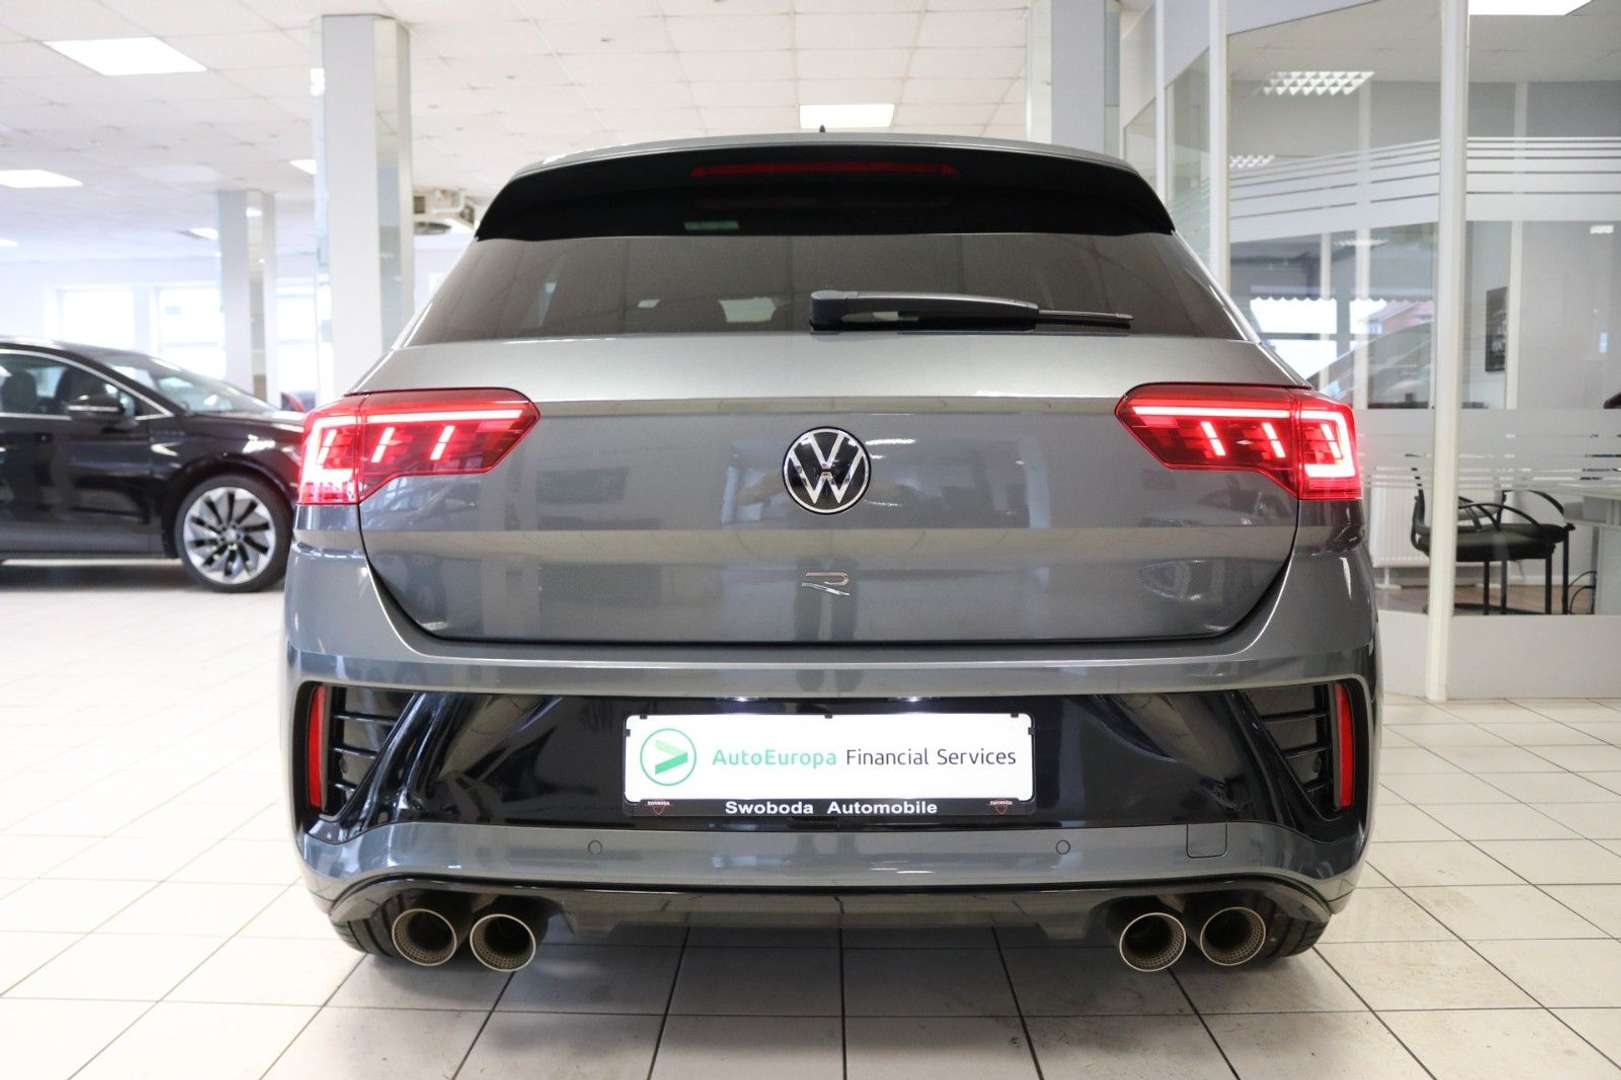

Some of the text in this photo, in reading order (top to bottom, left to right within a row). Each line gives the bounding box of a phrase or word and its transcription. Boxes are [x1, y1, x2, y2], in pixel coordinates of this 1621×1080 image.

[712, 747, 1017, 769] AutoEuropa Financial Services
[725, 800, 938, 815] Swoboda Automobile
